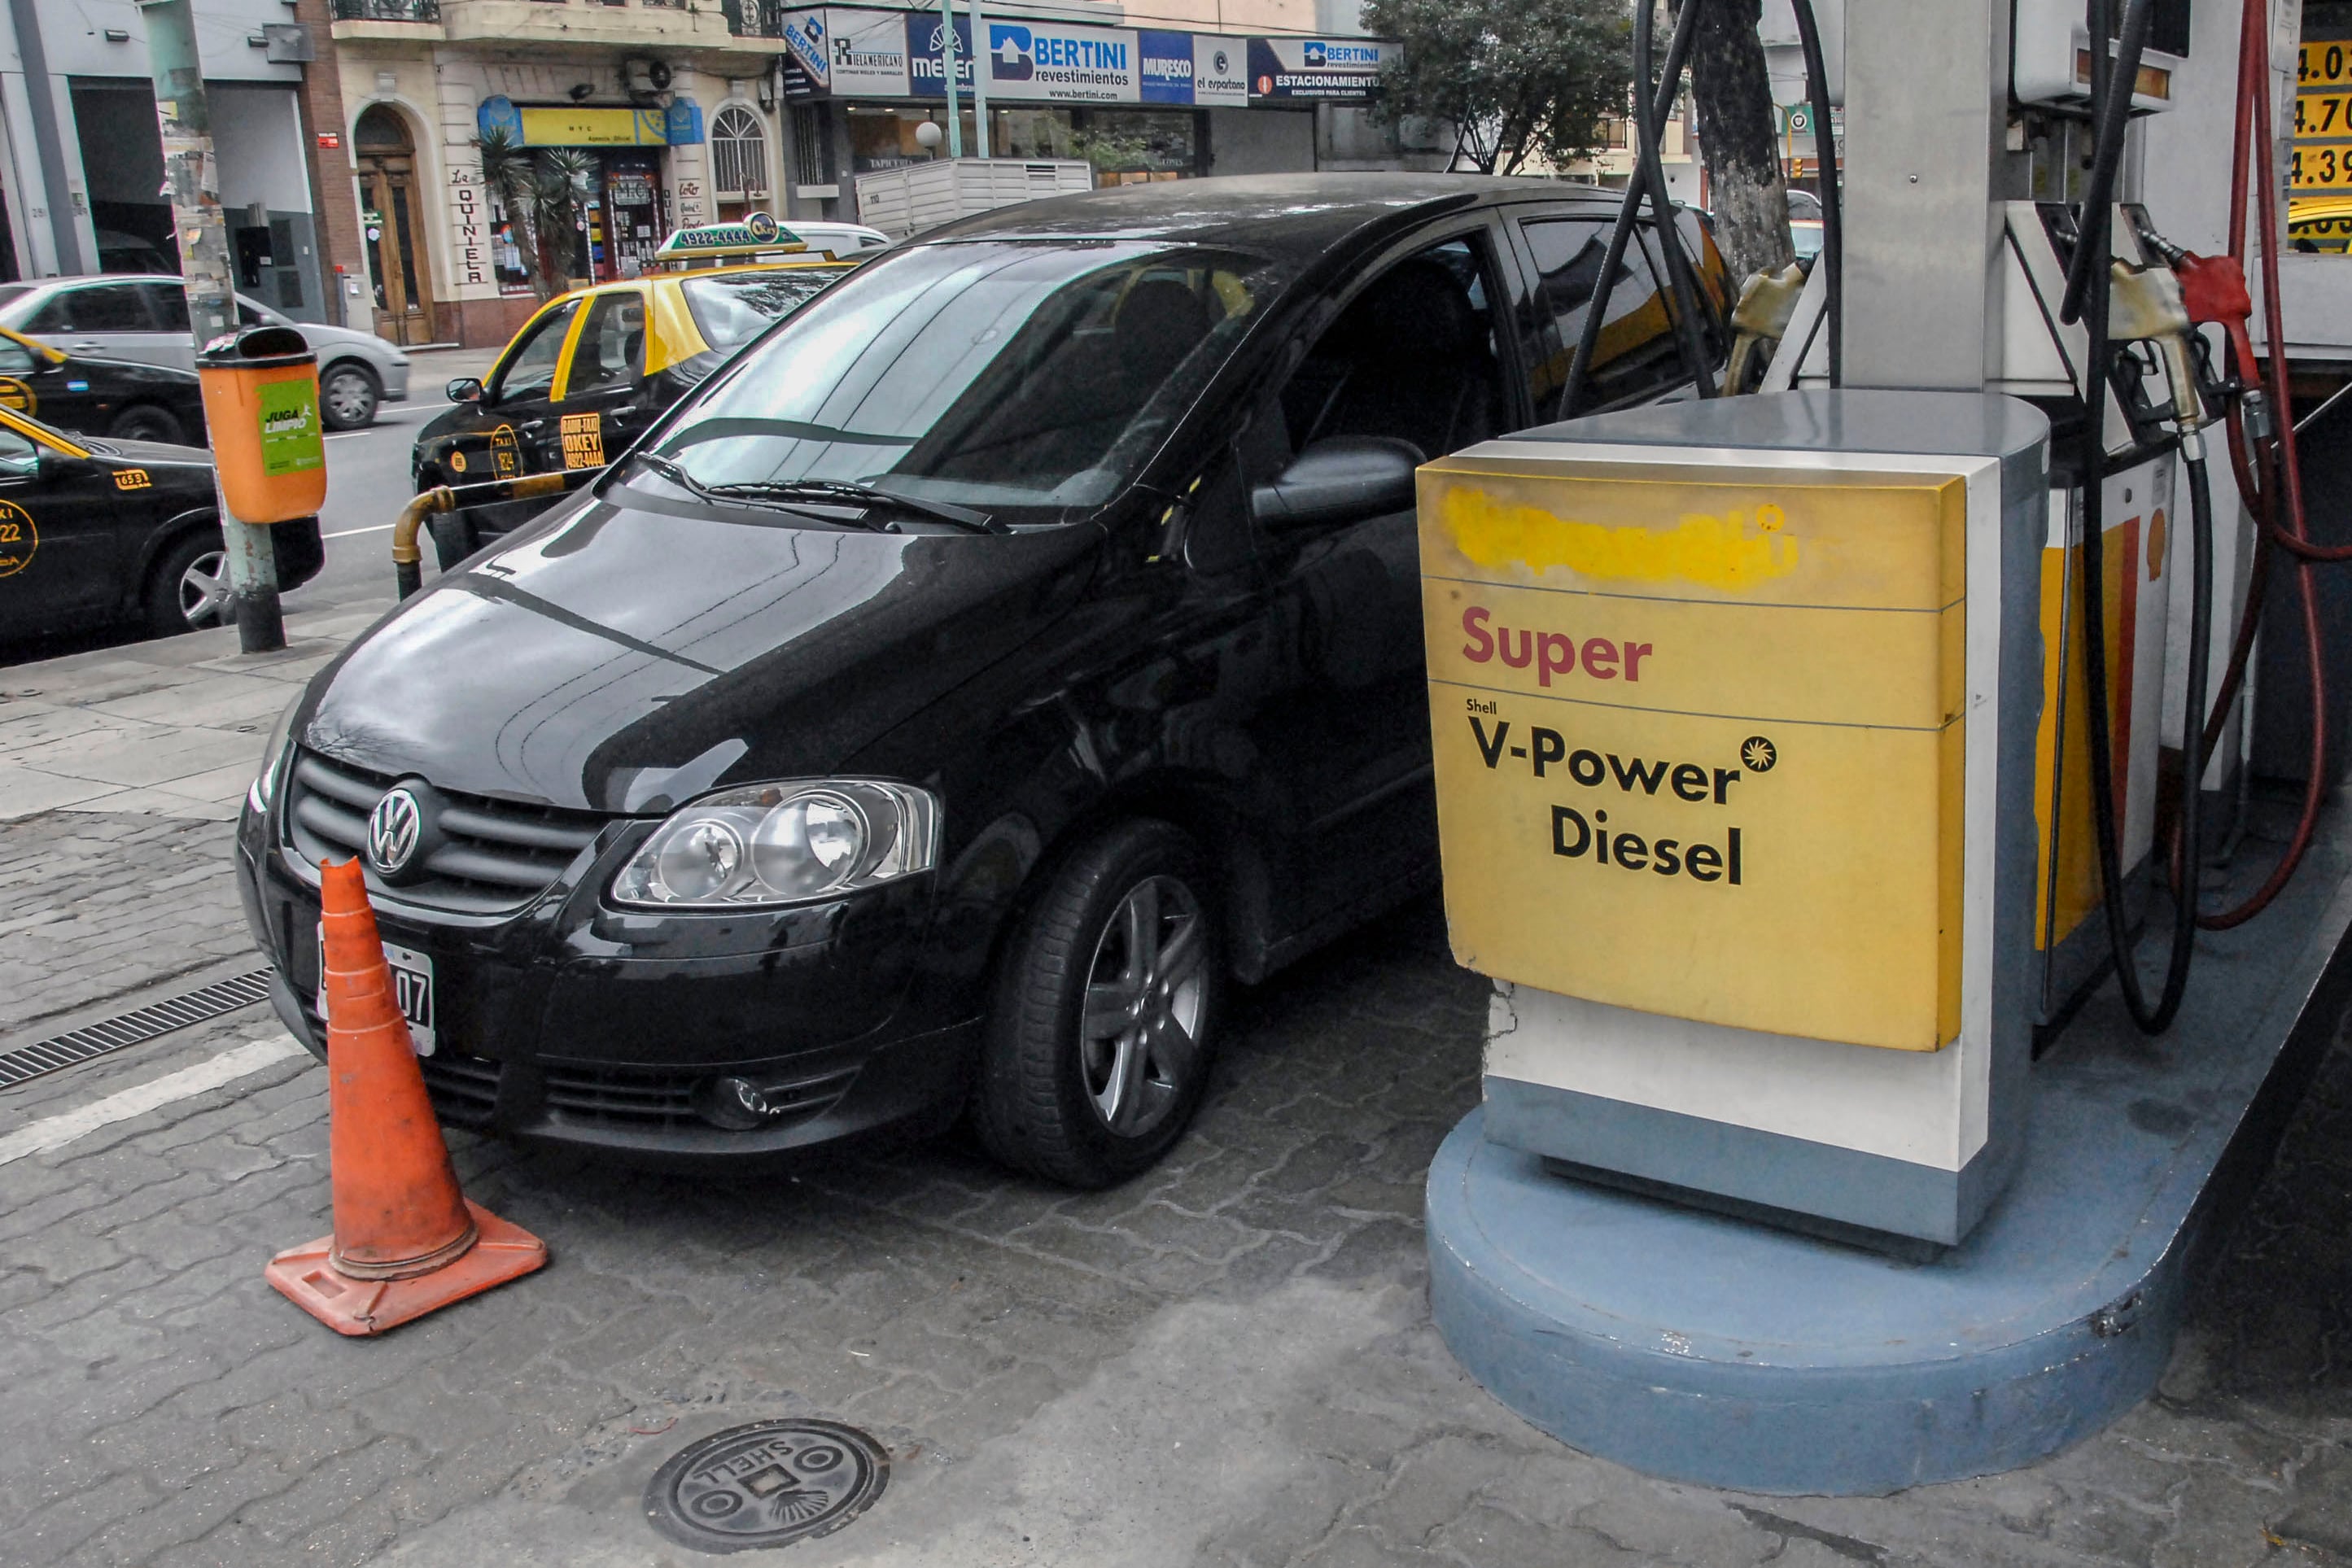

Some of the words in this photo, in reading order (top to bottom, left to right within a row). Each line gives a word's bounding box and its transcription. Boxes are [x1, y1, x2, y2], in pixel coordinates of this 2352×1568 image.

[786, 24, 827, 73] BERTINI
[1034, 37, 1126, 71] BERTINI
[1327, 47, 1379, 62] BERTINI
[2297, 45, 2352, 82] 4.0
[1035, 70, 1129, 86] revestimientos
[1143, 58, 1191, 81] MURESCO
[1049, 90, 1118, 101] www.bertini.com
[459, 189, 482, 283] QUINIELA
[680, 229, 751, 245] 4922-4444
[563, 434, 598, 452] OKEY
[1462, 606, 1653, 688] Super
[1466, 698, 1497, 715] Shell
[1467, 715, 1741, 805] V-Power
[1550, 804, 1742, 886] Diesel
[693, 1440, 794, 1484] SHELL
